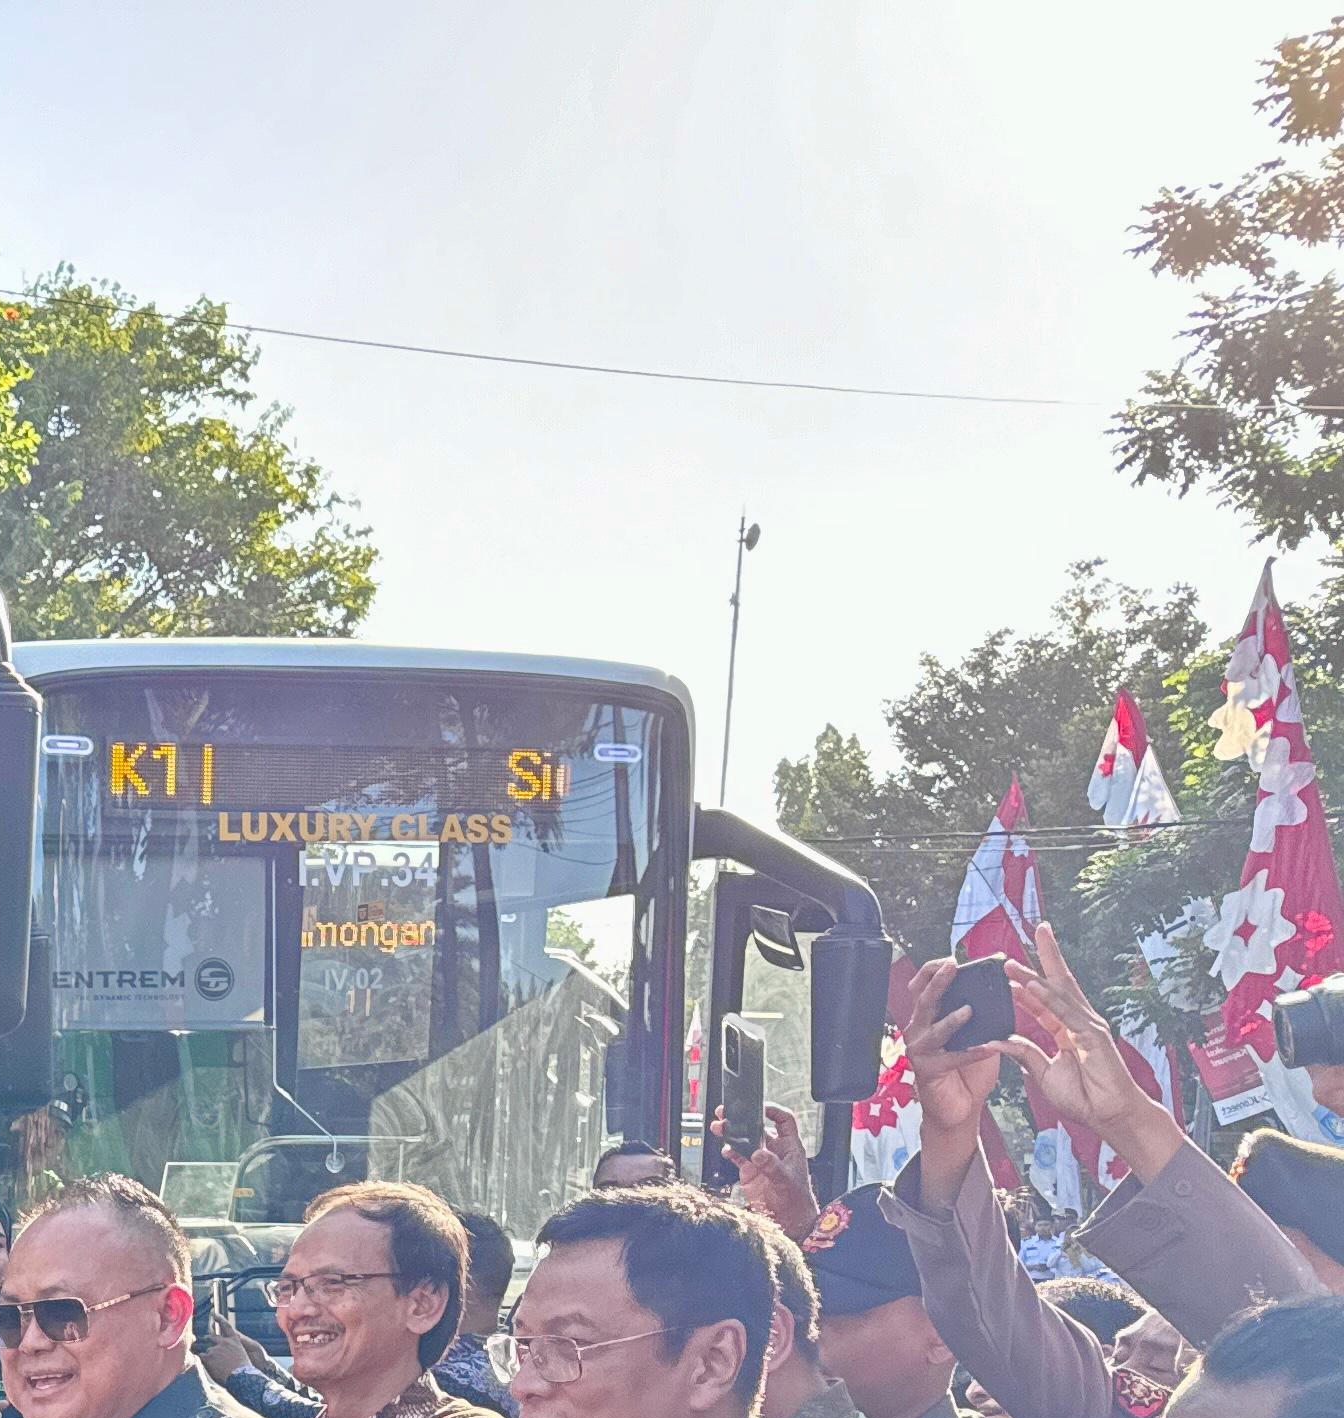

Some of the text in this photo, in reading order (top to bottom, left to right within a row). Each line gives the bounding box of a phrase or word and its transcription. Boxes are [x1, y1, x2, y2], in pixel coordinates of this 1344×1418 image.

[218, 811, 514, 845] LUXURY CLASS
[300, 919, 437, 954] mongan
[51, 970, 186, 989] ENTREM
